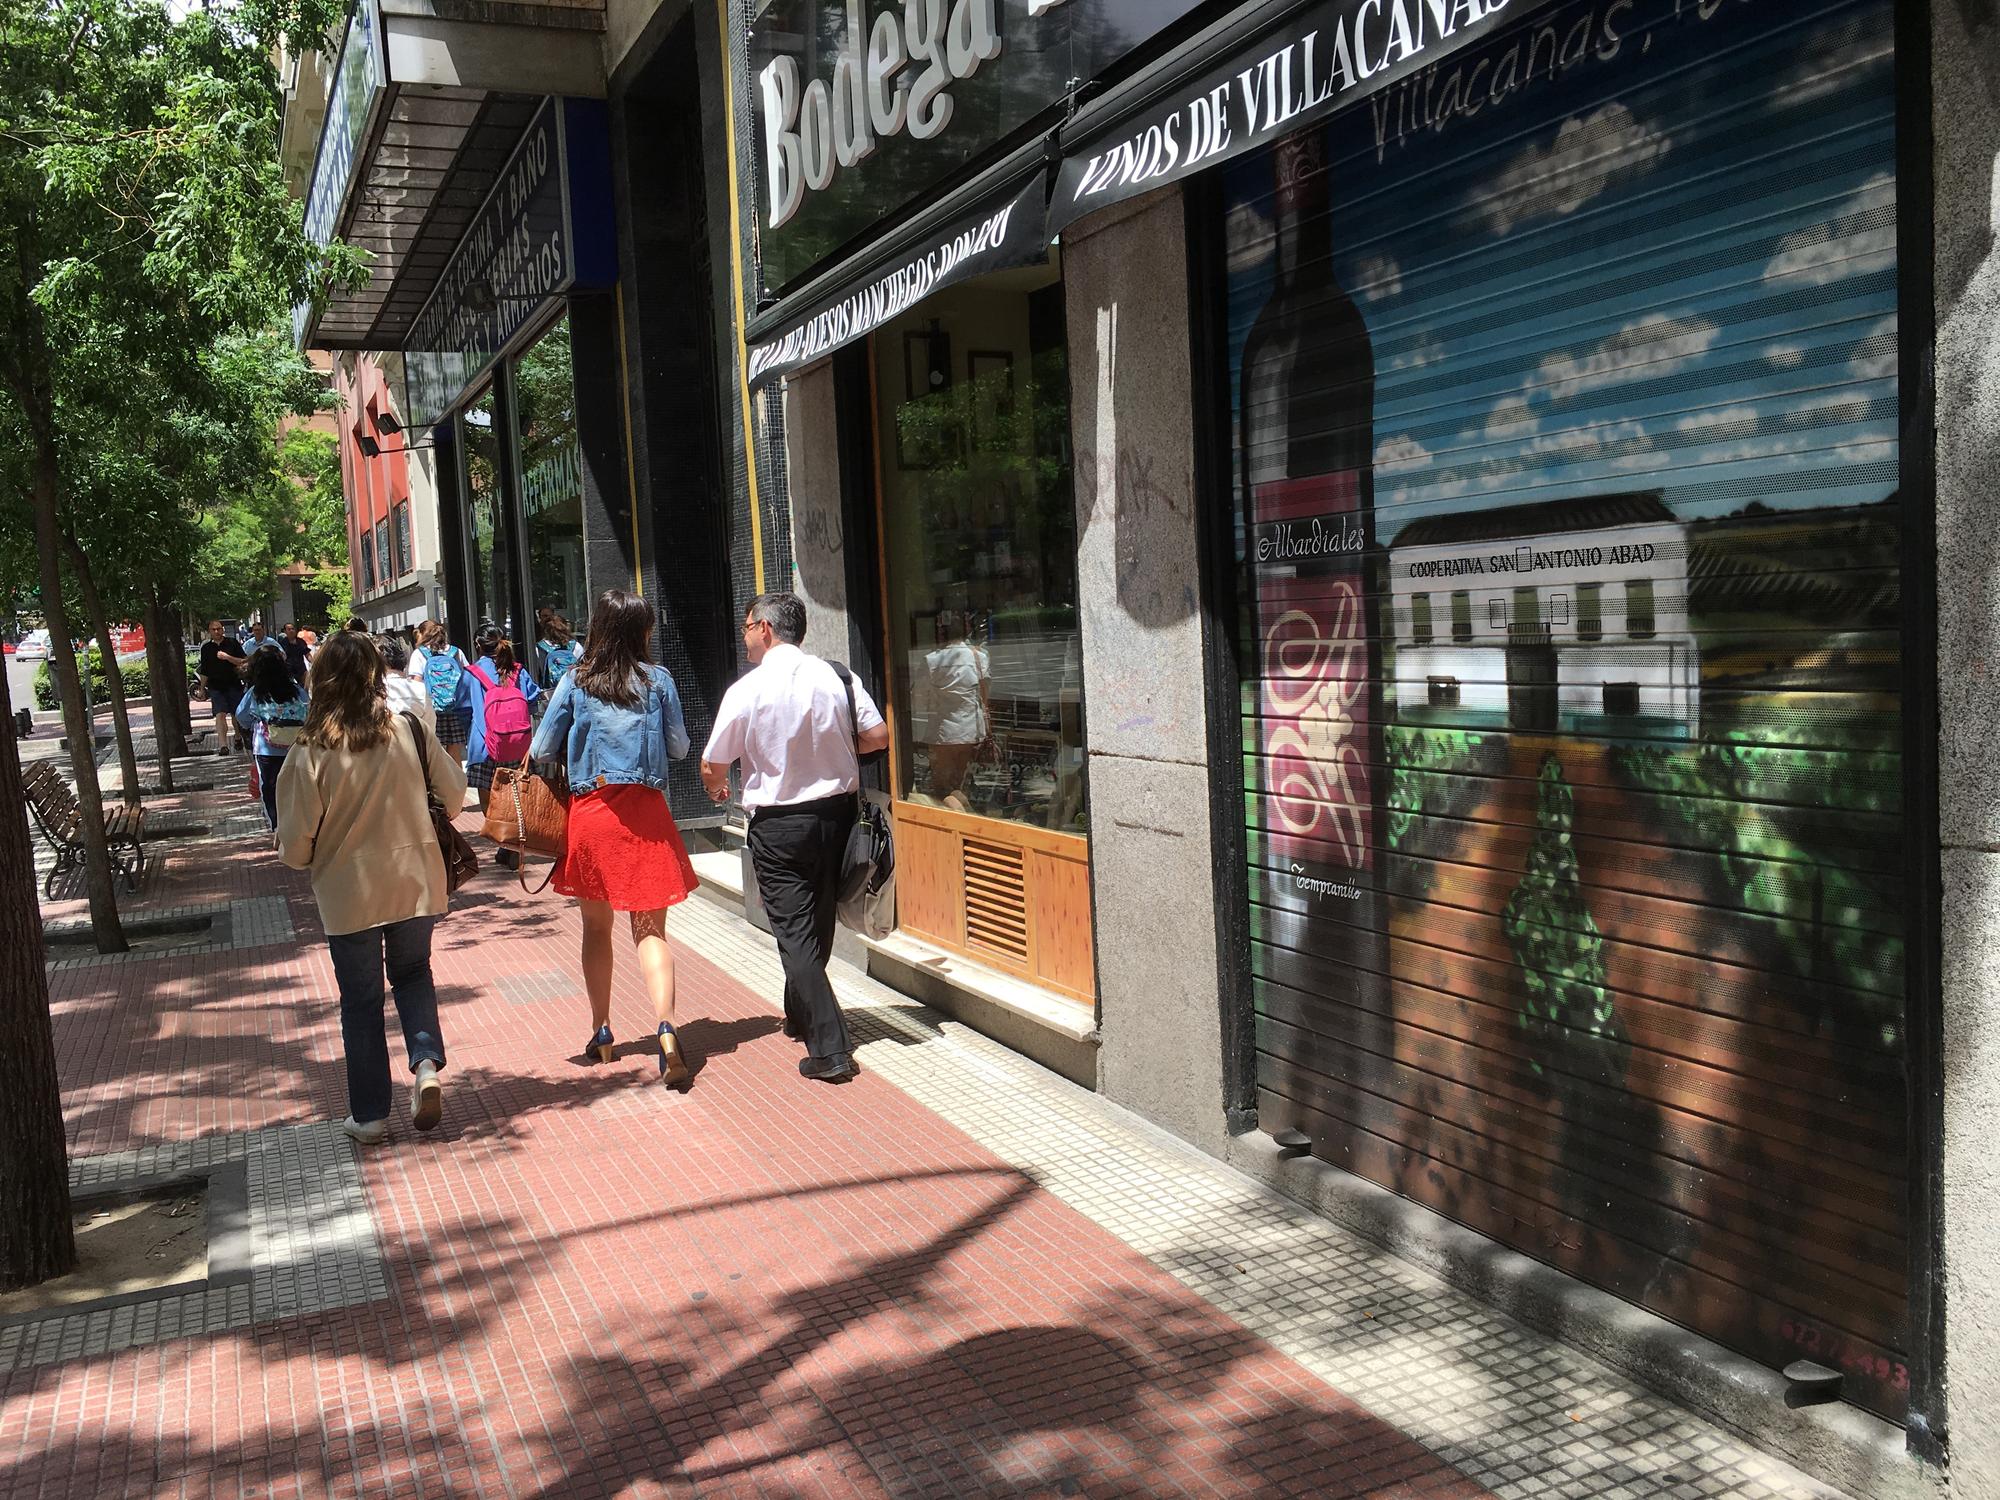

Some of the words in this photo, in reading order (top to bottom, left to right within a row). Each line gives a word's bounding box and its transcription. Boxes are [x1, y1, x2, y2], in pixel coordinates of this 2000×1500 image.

[760, 0, 1003, 229] Bodega
[1073, 111, 1182, 201] VINOS
[1182, 80, 1232, 168] DE
[1237, 0, 1511, 136] VILLACA
[457, 215, 494, 296] COCINA
[496, 192, 505, 236] Y
[509, 127, 548, 219] BAÑO
[483, 317, 492, 356] Y
[497, 230, 561, 345] ARMARIOS
[802, 299, 851, 360] QUESOS
[849, 250, 936, 338] MANCHEGOS
[521, 445, 582, 519] REFORMAS
[1257, 516, 1365, 561] Albardiales
[1409, 557, 1485, 578] COOPERATIVA
[1489, 554, 1517, 573] SAN
[1533, 547, 1602, 570] ANTONIO
[1608, 543, 1656, 565] ABAD
